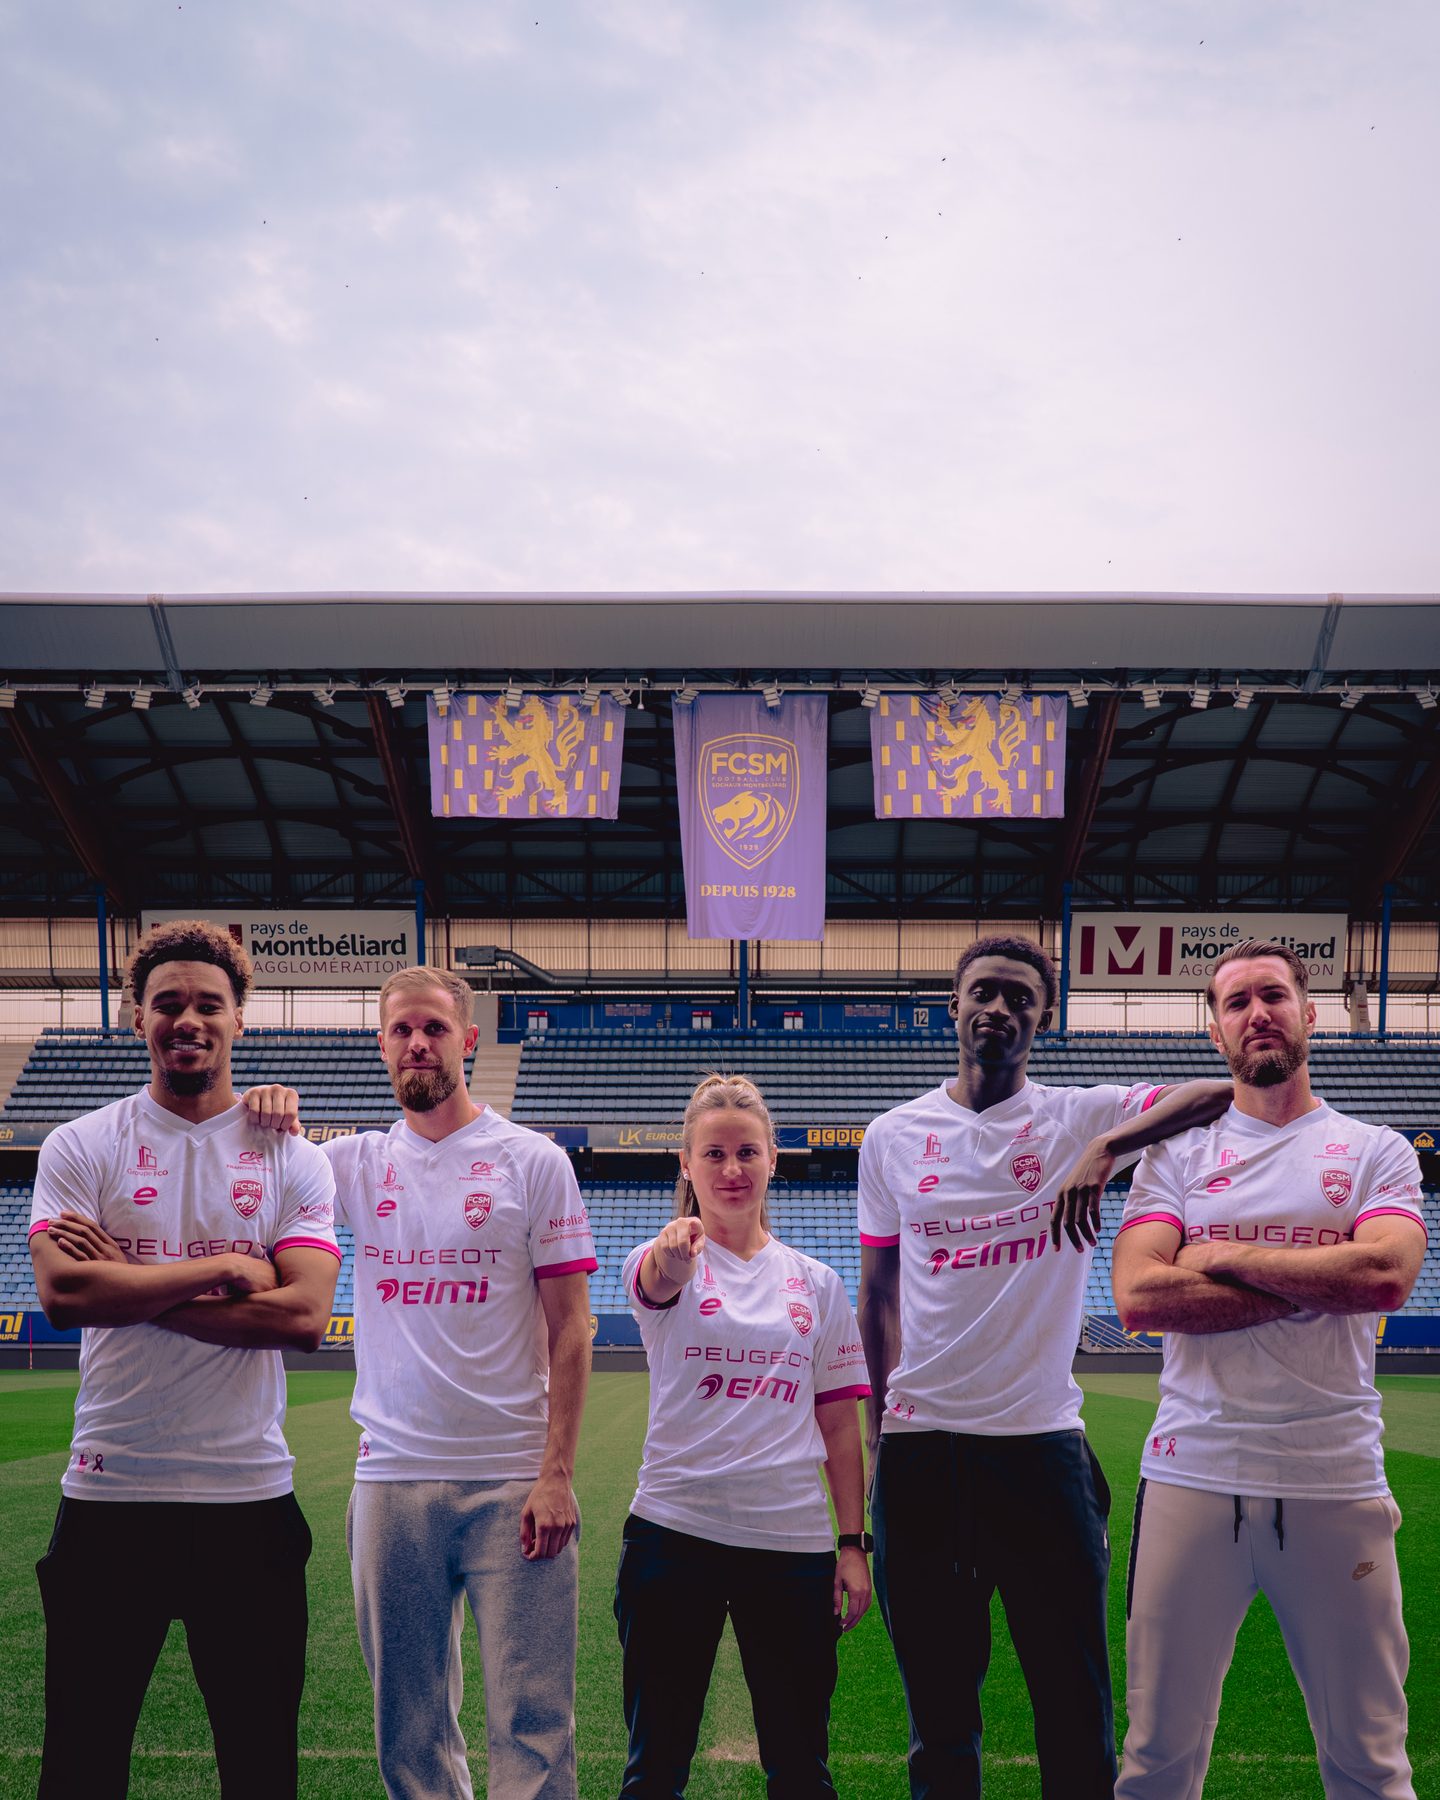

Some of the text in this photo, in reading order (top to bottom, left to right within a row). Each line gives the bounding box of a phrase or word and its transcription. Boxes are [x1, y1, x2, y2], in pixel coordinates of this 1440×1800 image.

[711, 752, 787, 775] FCSM
[700, 884, 797, 898] DEPUIS 1928
[250, 920, 309, 938] Pays de
[1181, 923, 1240, 941] Pays de
[251, 933, 407, 956] Montbéliard
[253, 957, 408, 973] AGGLOMÉRATION
[914, 1010, 928, 1025] 12
[1013, 1156, 1038, 1168] FCSM
[1324, 1172, 1350, 1181] FCSM
[235, 1182, 261, 1191] FCSM
[467, 1196, 491, 1204] FCSM
[549, 1215, 583, 1230] Néolia
[115, 1237, 266, 1259] PEUGEO
[364, 1245, 502, 1265] PEUGEOT
